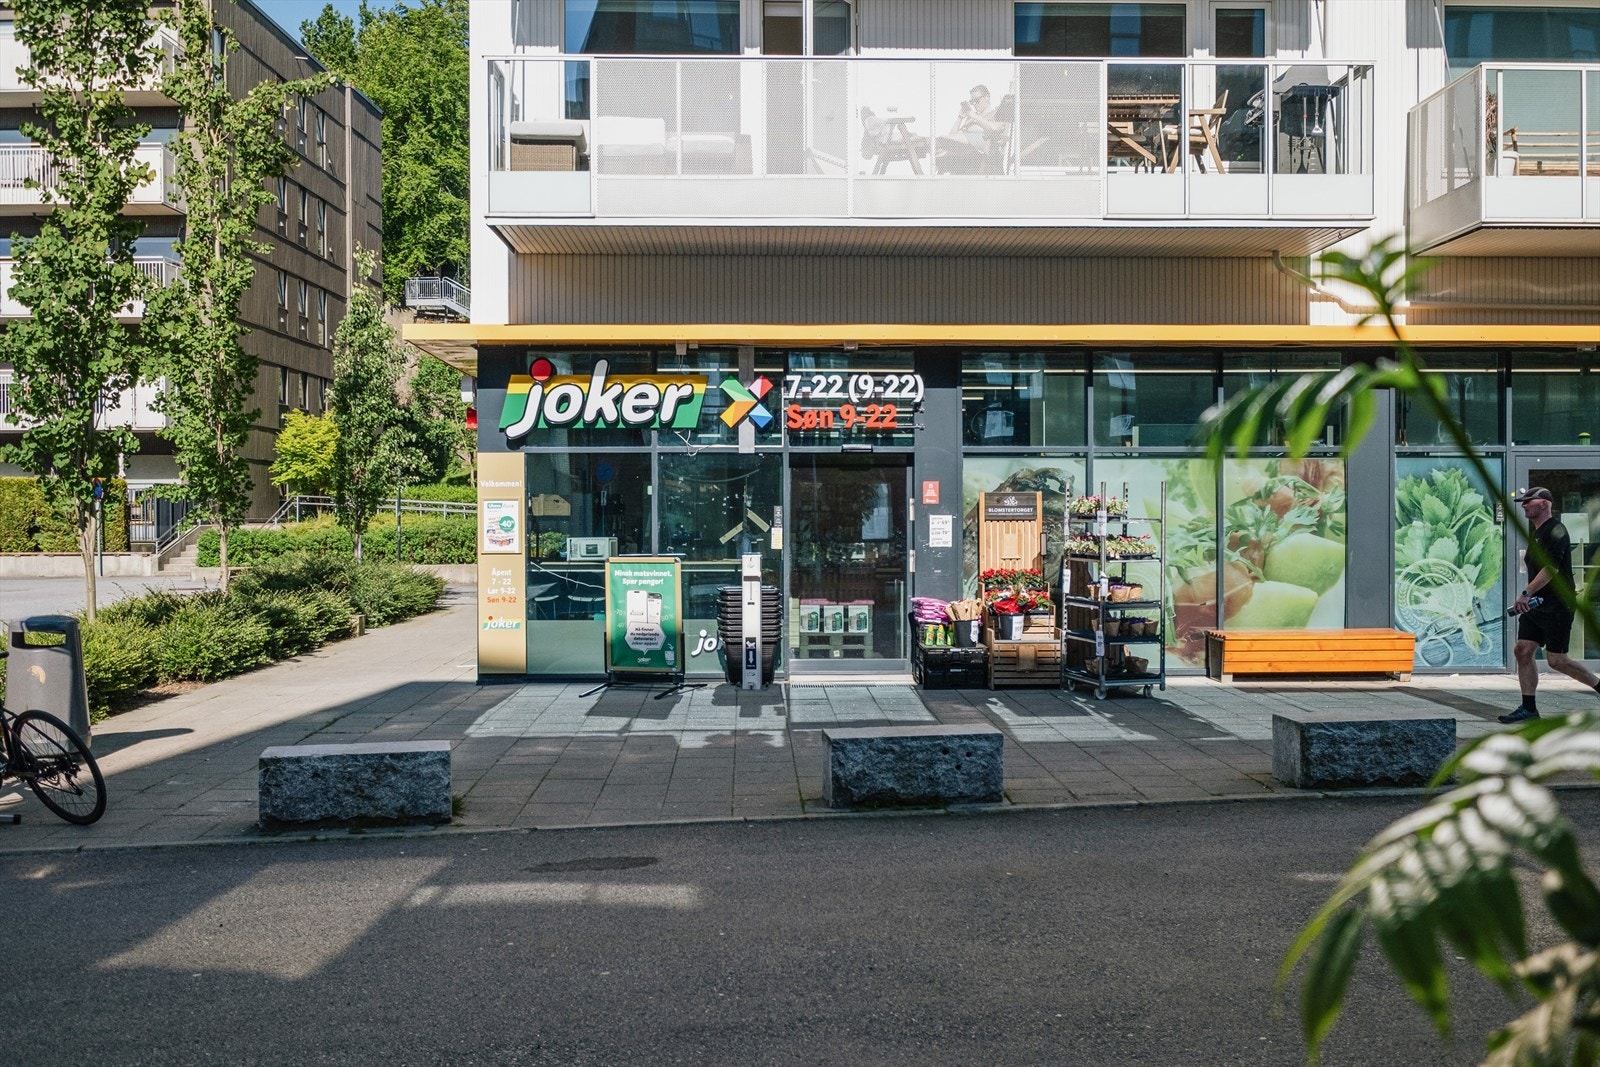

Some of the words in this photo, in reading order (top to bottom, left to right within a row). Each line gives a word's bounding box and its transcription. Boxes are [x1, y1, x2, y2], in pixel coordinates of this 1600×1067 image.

[786, 374, 844, 399] 7-22
[848, 374, 925, 403] (9-22)
[505, 357, 694, 439] joker
[786, 403, 834, 430] Søn
[839, 403, 898, 429] 9-22
[480, 480, 522, 488] Velkommen!
[622, 578, 637, 586] Spar
[638, 578, 664, 586] penger!
[500, 587, 517, 595] 9-22
[483, 616, 519, 630] joker
